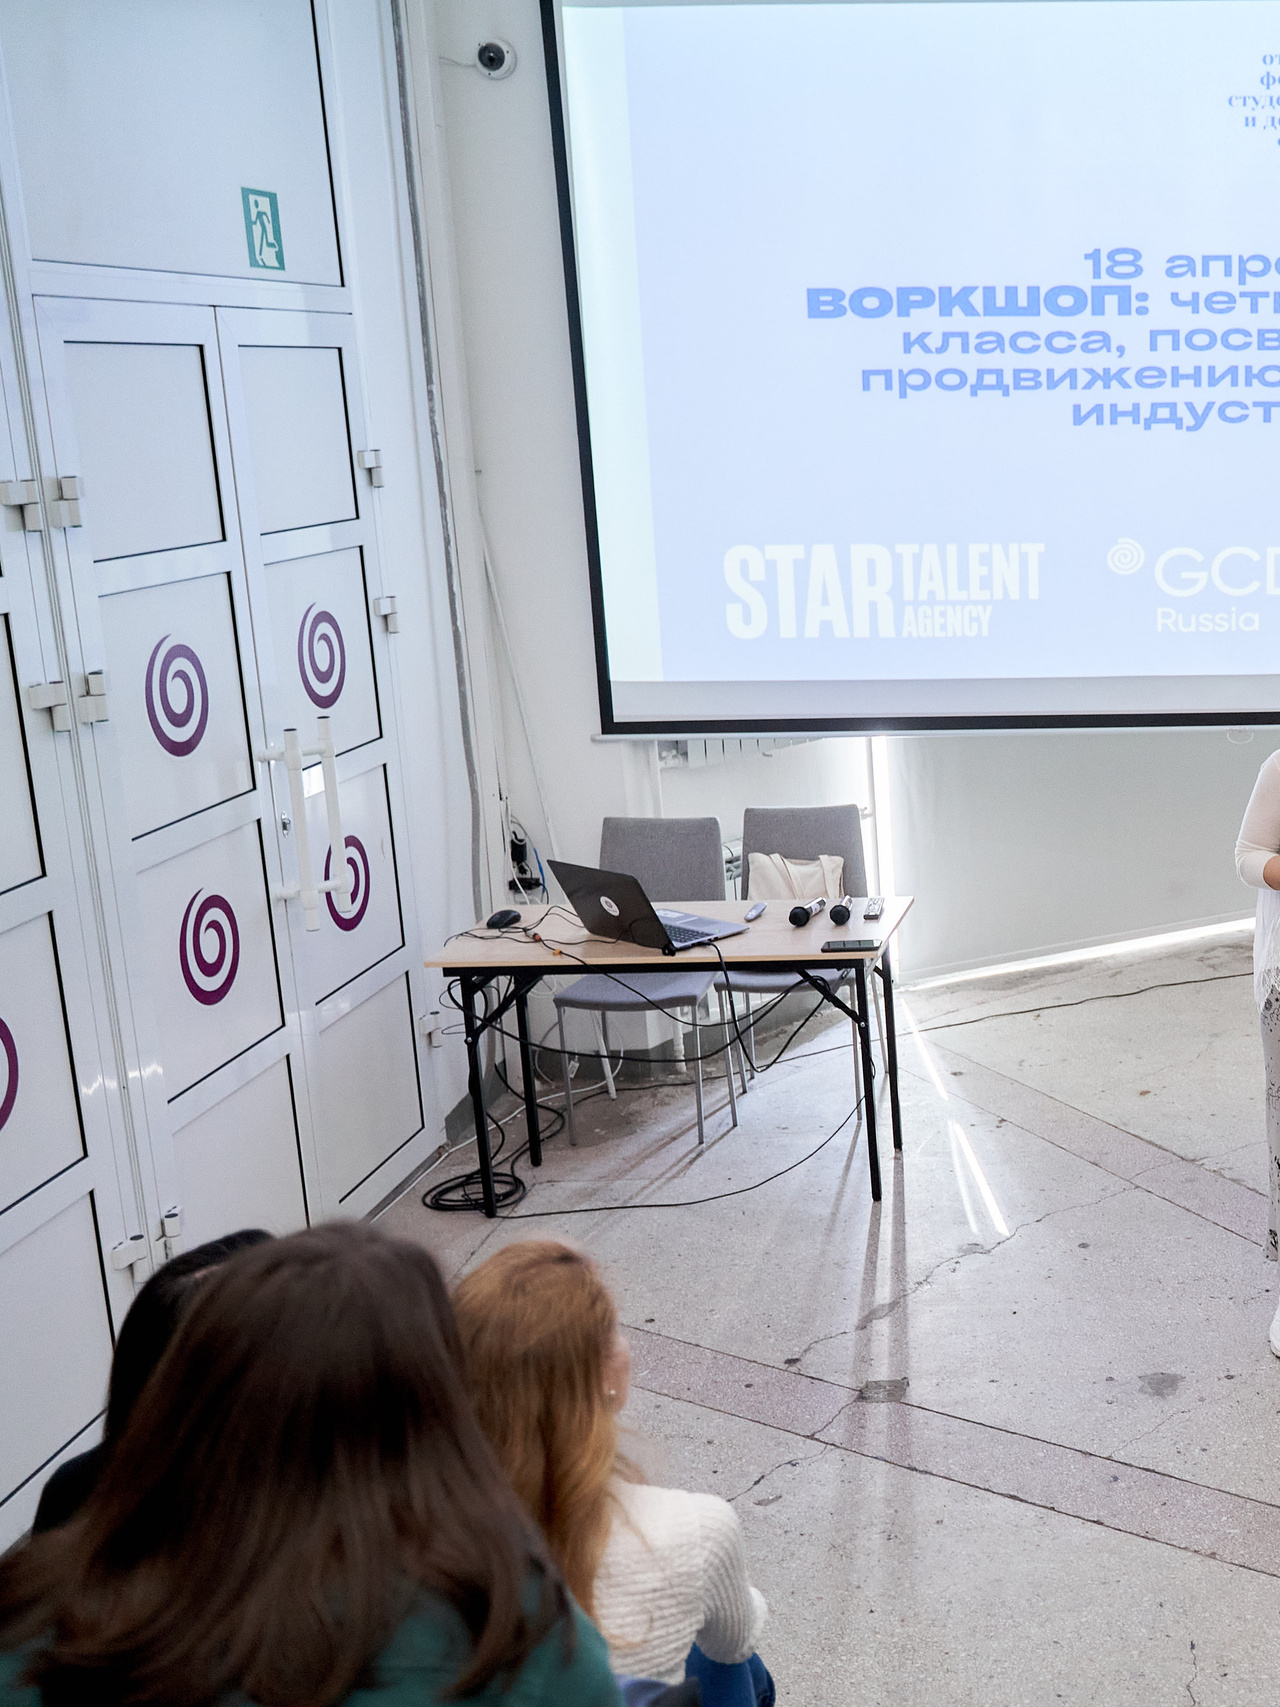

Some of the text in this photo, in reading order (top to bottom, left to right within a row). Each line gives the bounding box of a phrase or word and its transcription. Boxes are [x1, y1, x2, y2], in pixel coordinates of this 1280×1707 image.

[1244, 115, 1256, 127] и
[1084, 247, 1143, 279] 18
[806, 285, 1150, 318] ВОРКШОП:
[903, 330, 1126, 358] класса,
[723, 542, 1045, 640] STAR TALENT
[902, 605, 993, 638] AGENCY
[1157, 606, 1260, 633] Russia
